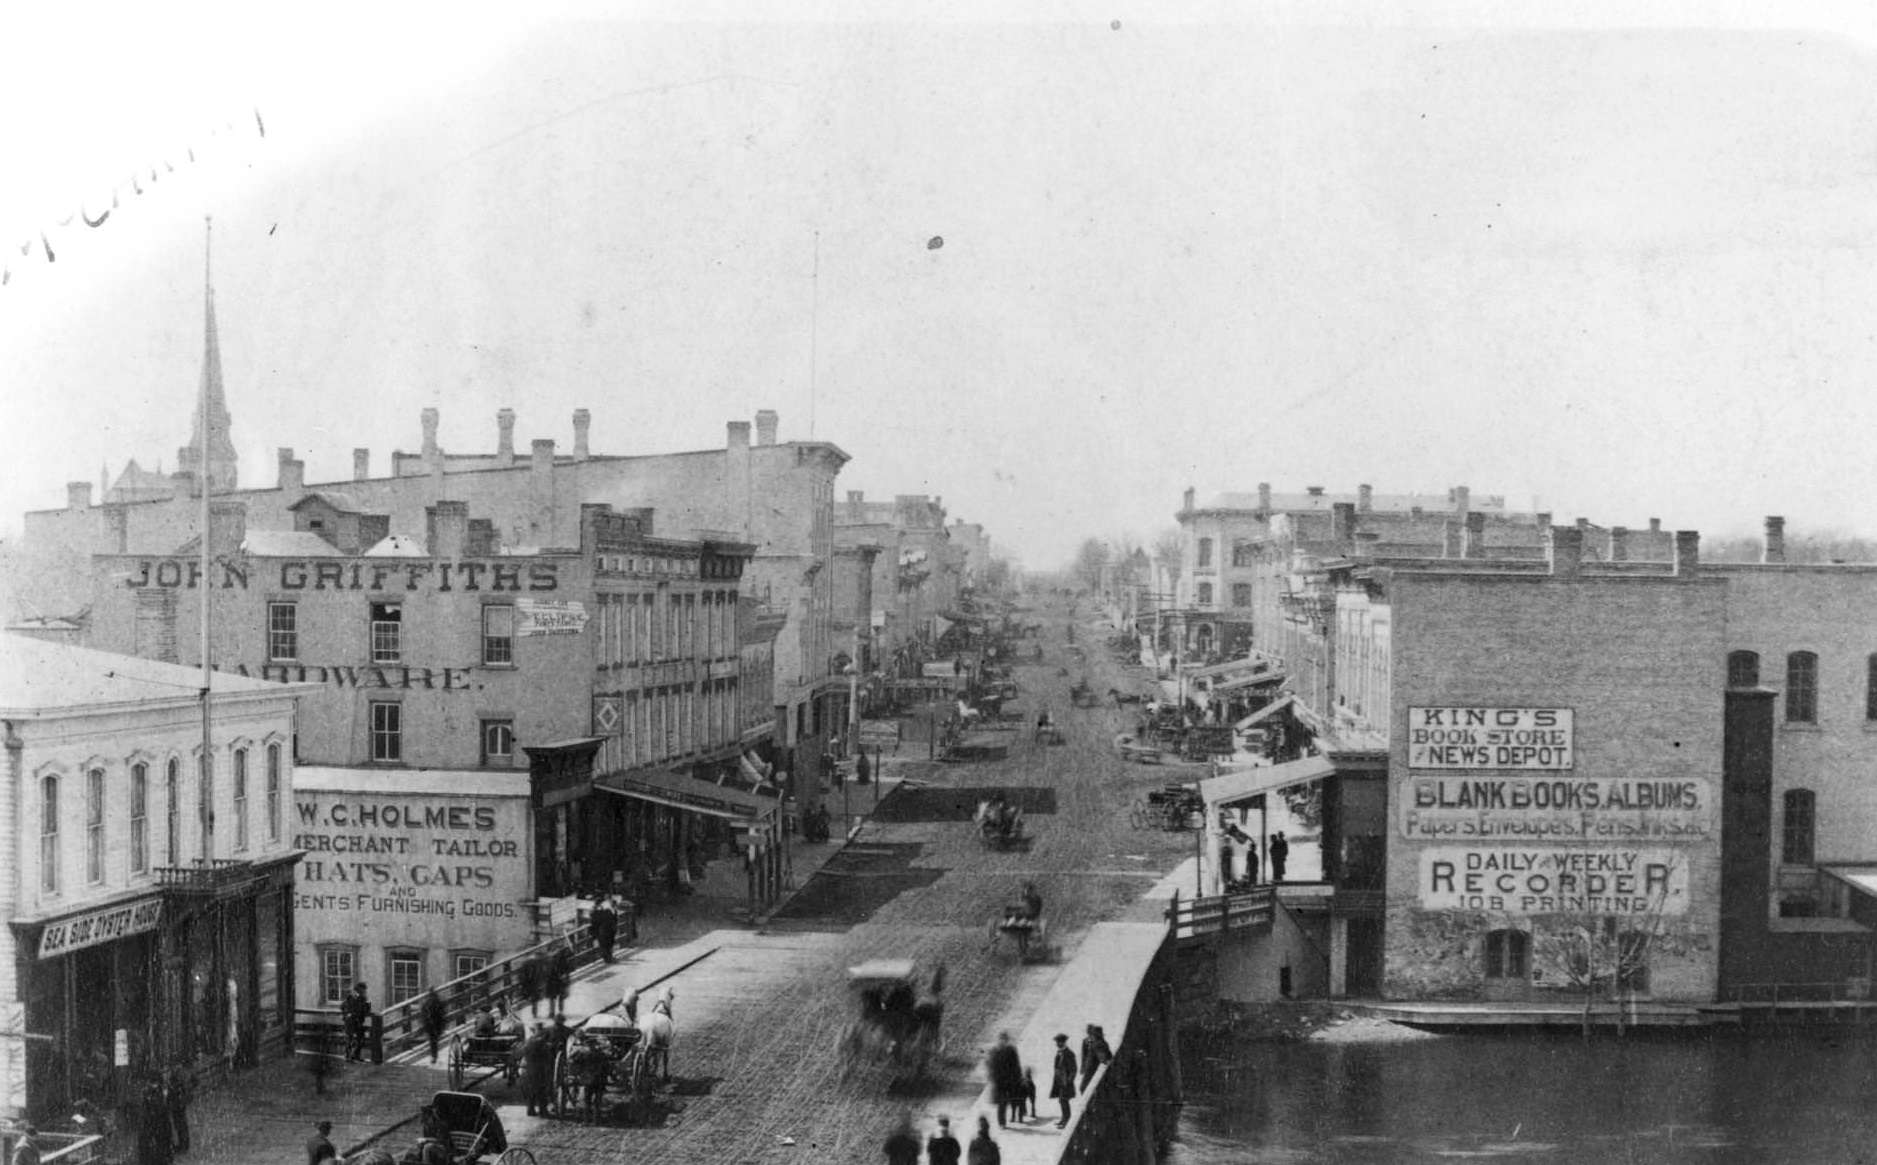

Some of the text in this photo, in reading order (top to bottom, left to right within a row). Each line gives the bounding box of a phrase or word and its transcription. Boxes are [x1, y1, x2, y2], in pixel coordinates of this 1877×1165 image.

[126, 561, 558, 592] JOHN GRIFFITHS
[1424, 709, 1557, 727] KING'S
[1412, 729, 1566, 746] BOOK STORE
[1429, 746, 1490, 765] NEWS
[1497, 746, 1571, 767] DEPOT.
[1415, 780, 1506, 809] BLANK
[432, 839, 518, 858] TAILOR
[1466, 853, 1539, 871] DAILY
[1553, 854, 1637, 872] WEEKLY
[411, 865, 493, 888] CAPS
[389, 887, 417, 898] AND
[1458, 895, 1650, 912] JOB PRINTING
[44, 927, 66, 951] SEA
[69, 918, 94, 944] SIDE
